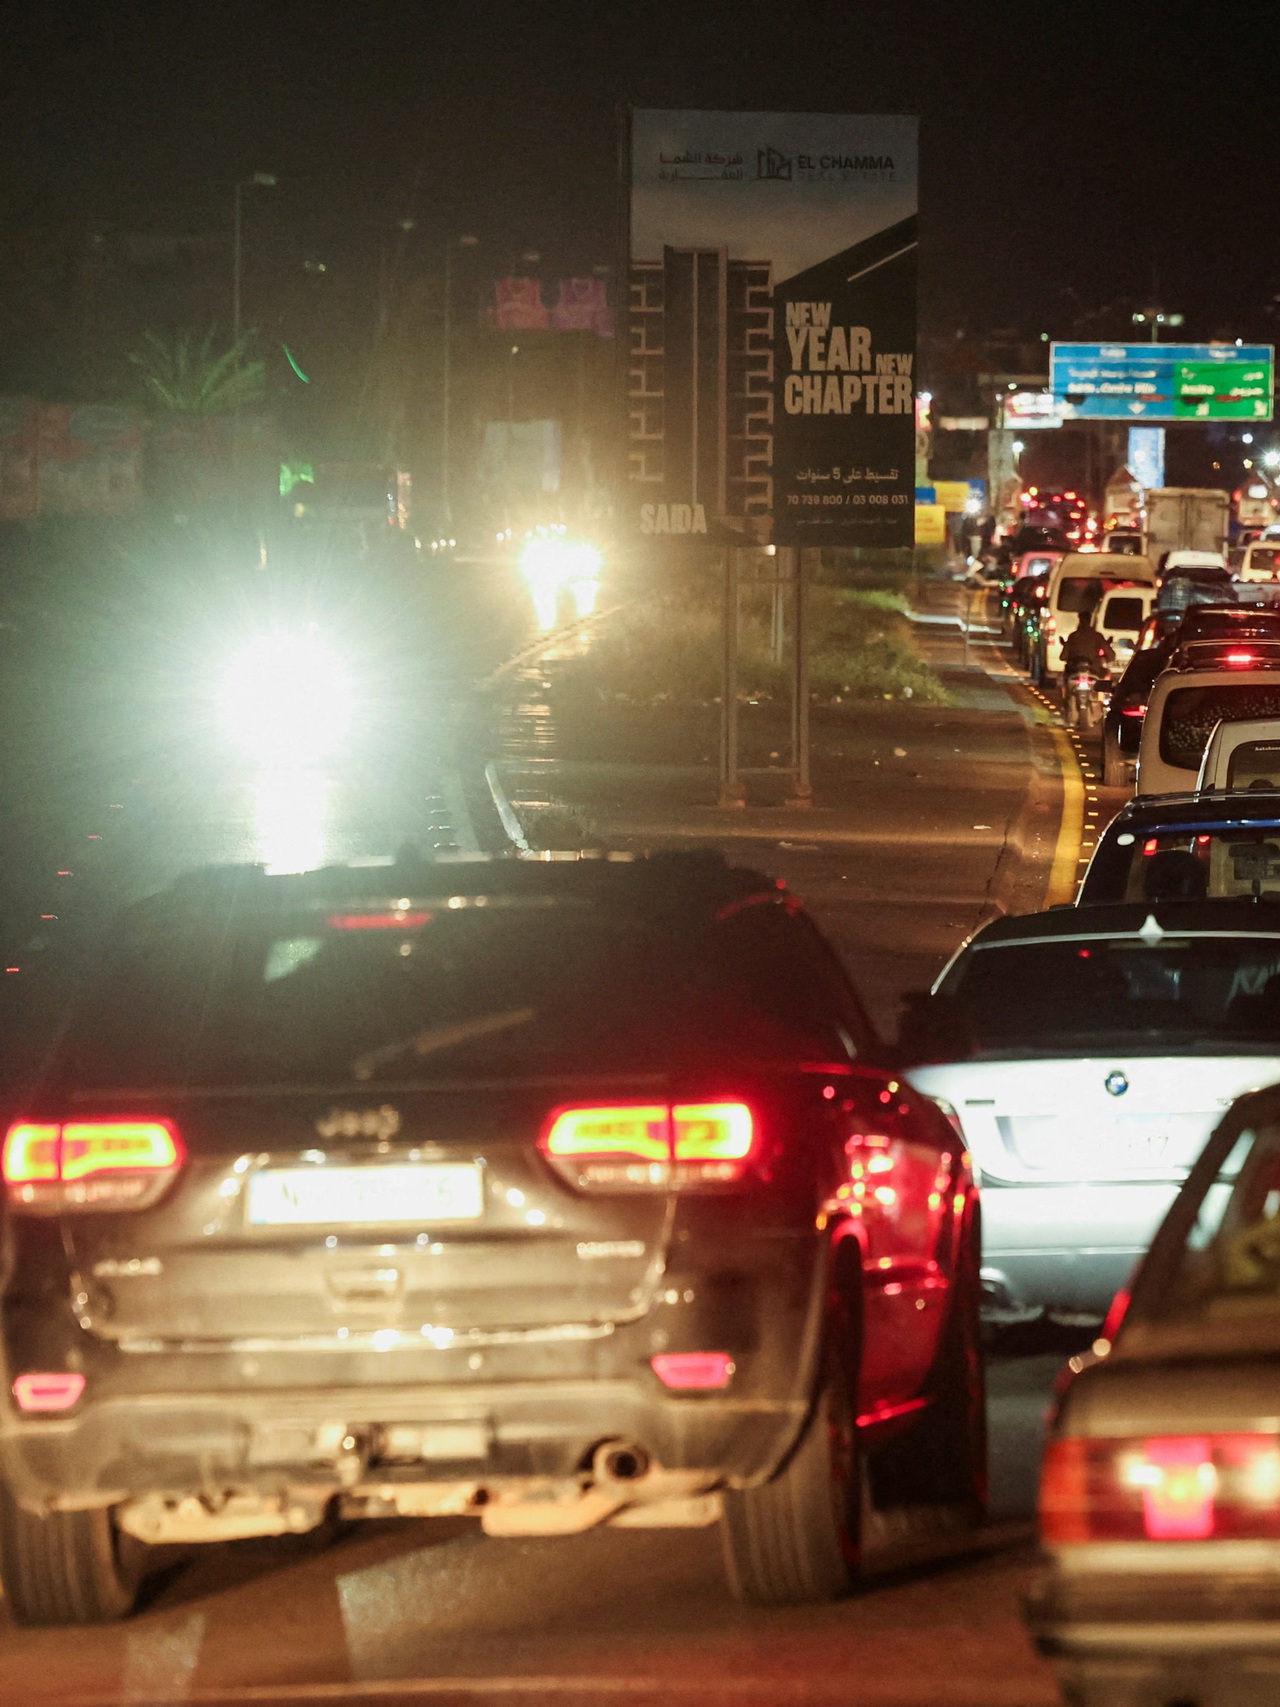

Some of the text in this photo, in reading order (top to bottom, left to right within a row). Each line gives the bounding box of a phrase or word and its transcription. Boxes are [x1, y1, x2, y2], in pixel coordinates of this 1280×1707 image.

[798, 155, 896, 171] EL CHAMMA
[786, 302, 832, 327] NEW
[786, 327, 873, 372] YEAR
[876, 354, 913, 376] NEW
[784, 375, 913, 415] CHAPTER
[833, 468, 841, 480] 5
[787, 495, 799, 505] 70
[852, 495, 866, 505] 03
[891, 495, 909, 505] 031
[640, 503, 707, 535] SAIDA
